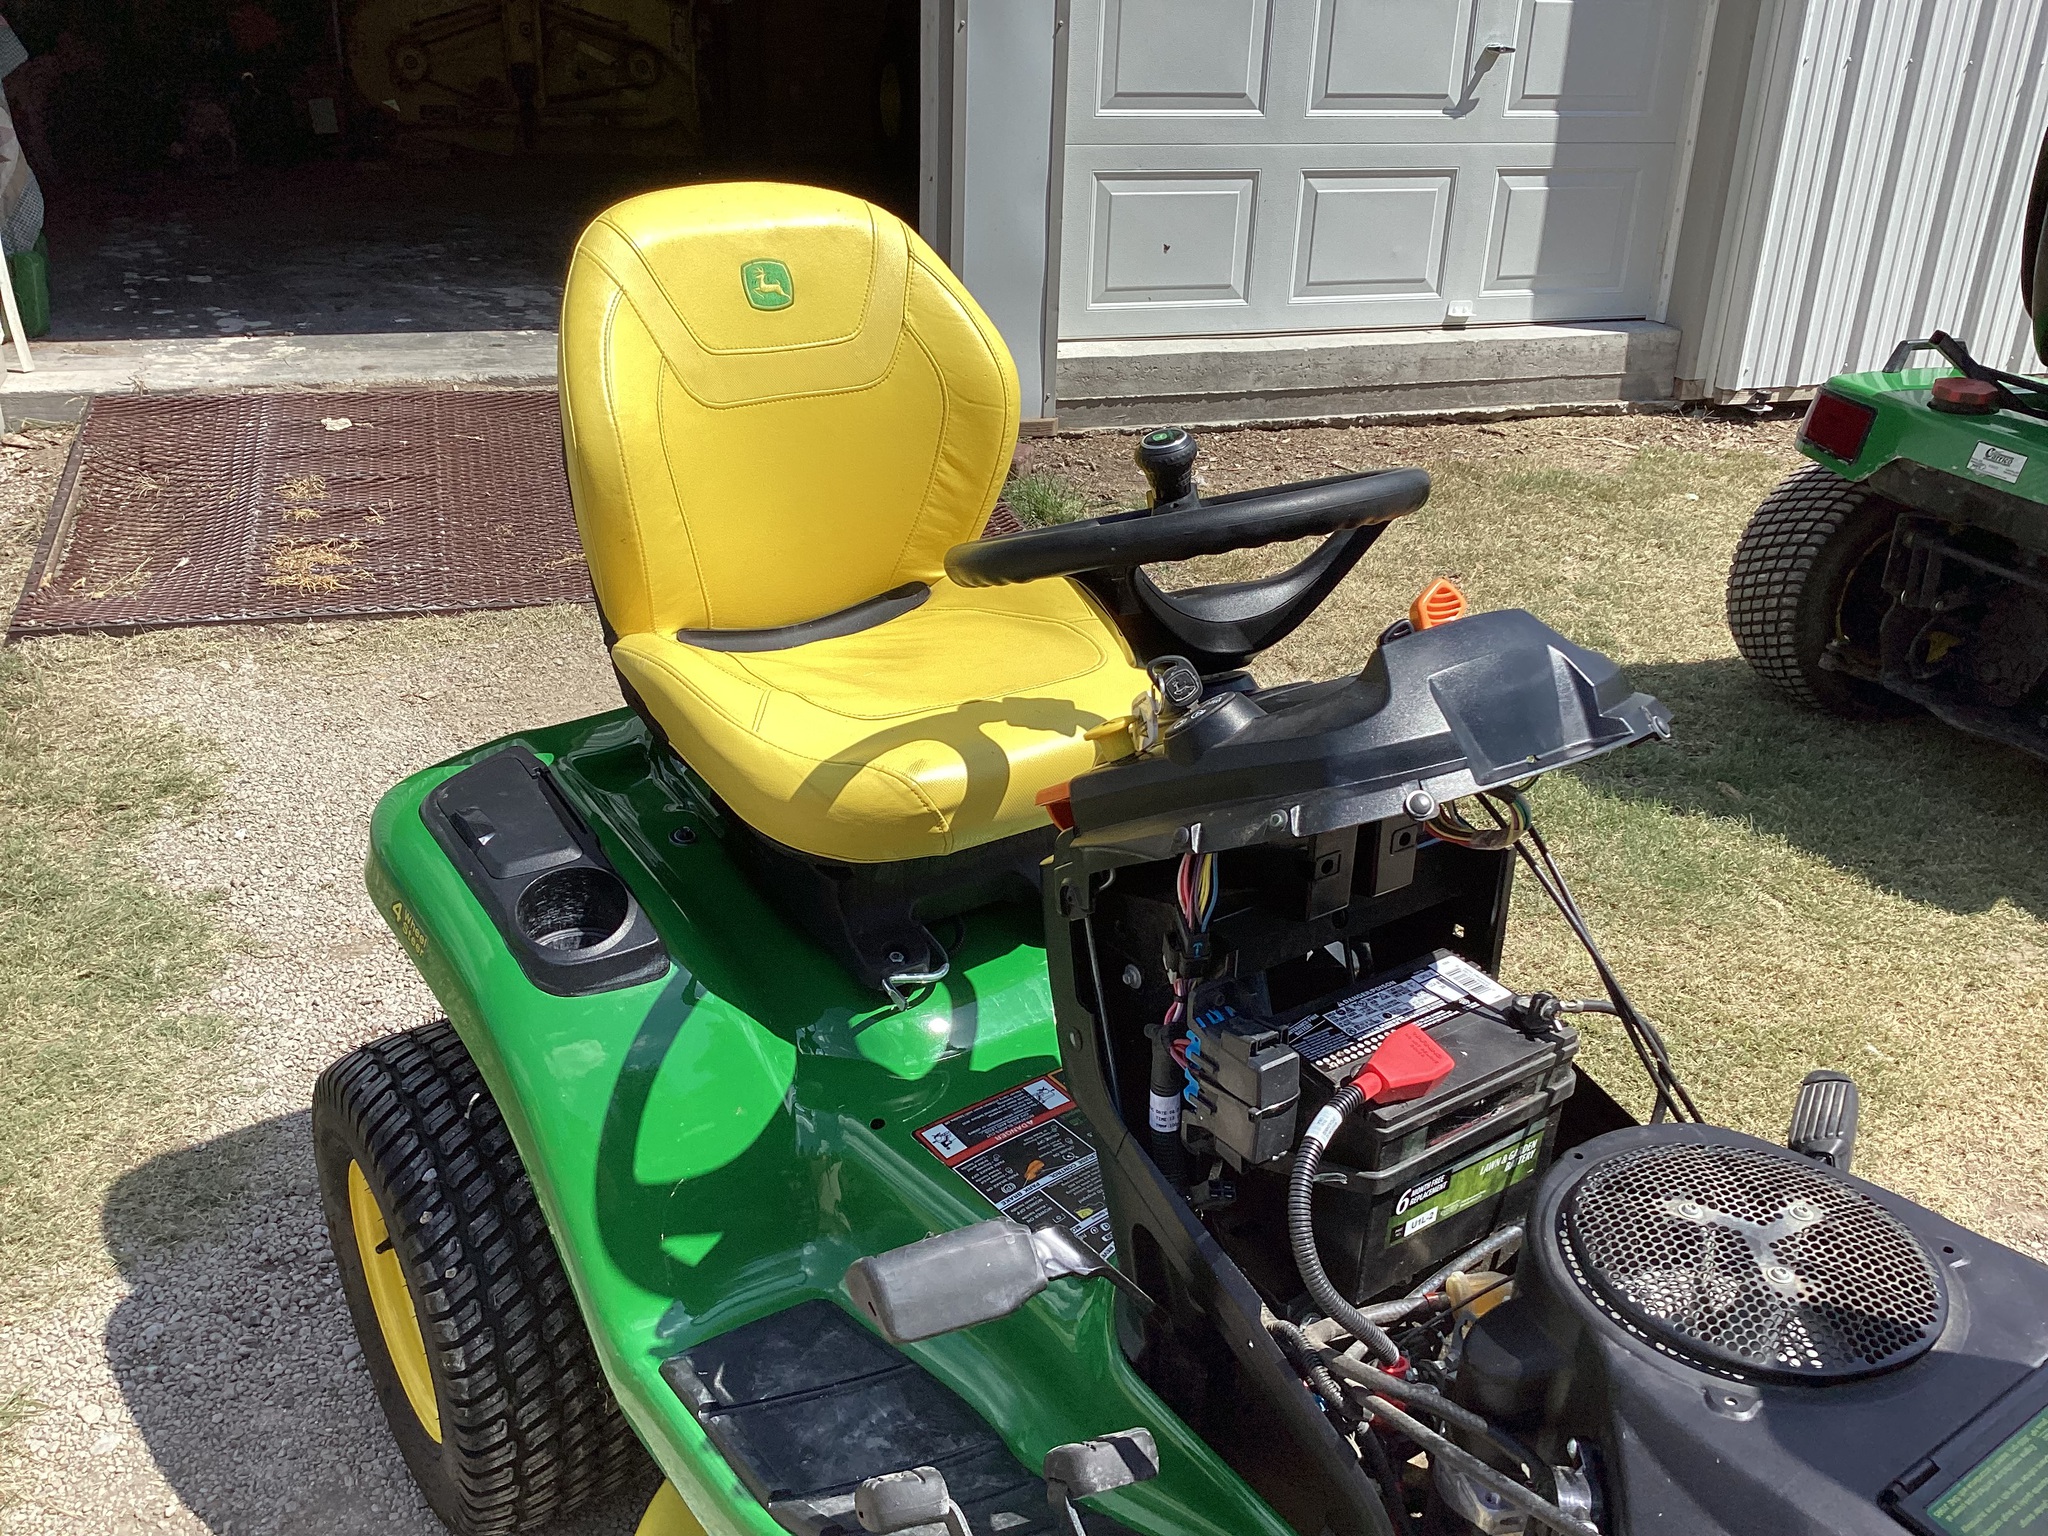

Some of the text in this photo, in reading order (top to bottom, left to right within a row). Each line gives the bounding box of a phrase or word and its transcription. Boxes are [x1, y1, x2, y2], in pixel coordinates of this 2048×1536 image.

[392, 902, 402, 922] 4
[402, 922, 424, 956] Steer
[404, 911, 427, 948] Wheel
[994, 1123, 1028, 1141] DANGER
[1479, 1159, 1501, 1176] LAWN
[1508, 1139, 1538, 1160] GARDEN
[1504, 1149, 1537, 1172] BATTERY
[1050, 1162, 1076, 1180] CONTROL
[1001, 1182, 1040, 1206] PARK BRAKE
[1409, 1182, 1448, 1206] REPLACEMENT
[1411, 1174, 1445, 1197] MONTH FREE
[1395, 1188, 1412, 1216] 6
[1411, 1211, 1435, 1229] U1L-2
